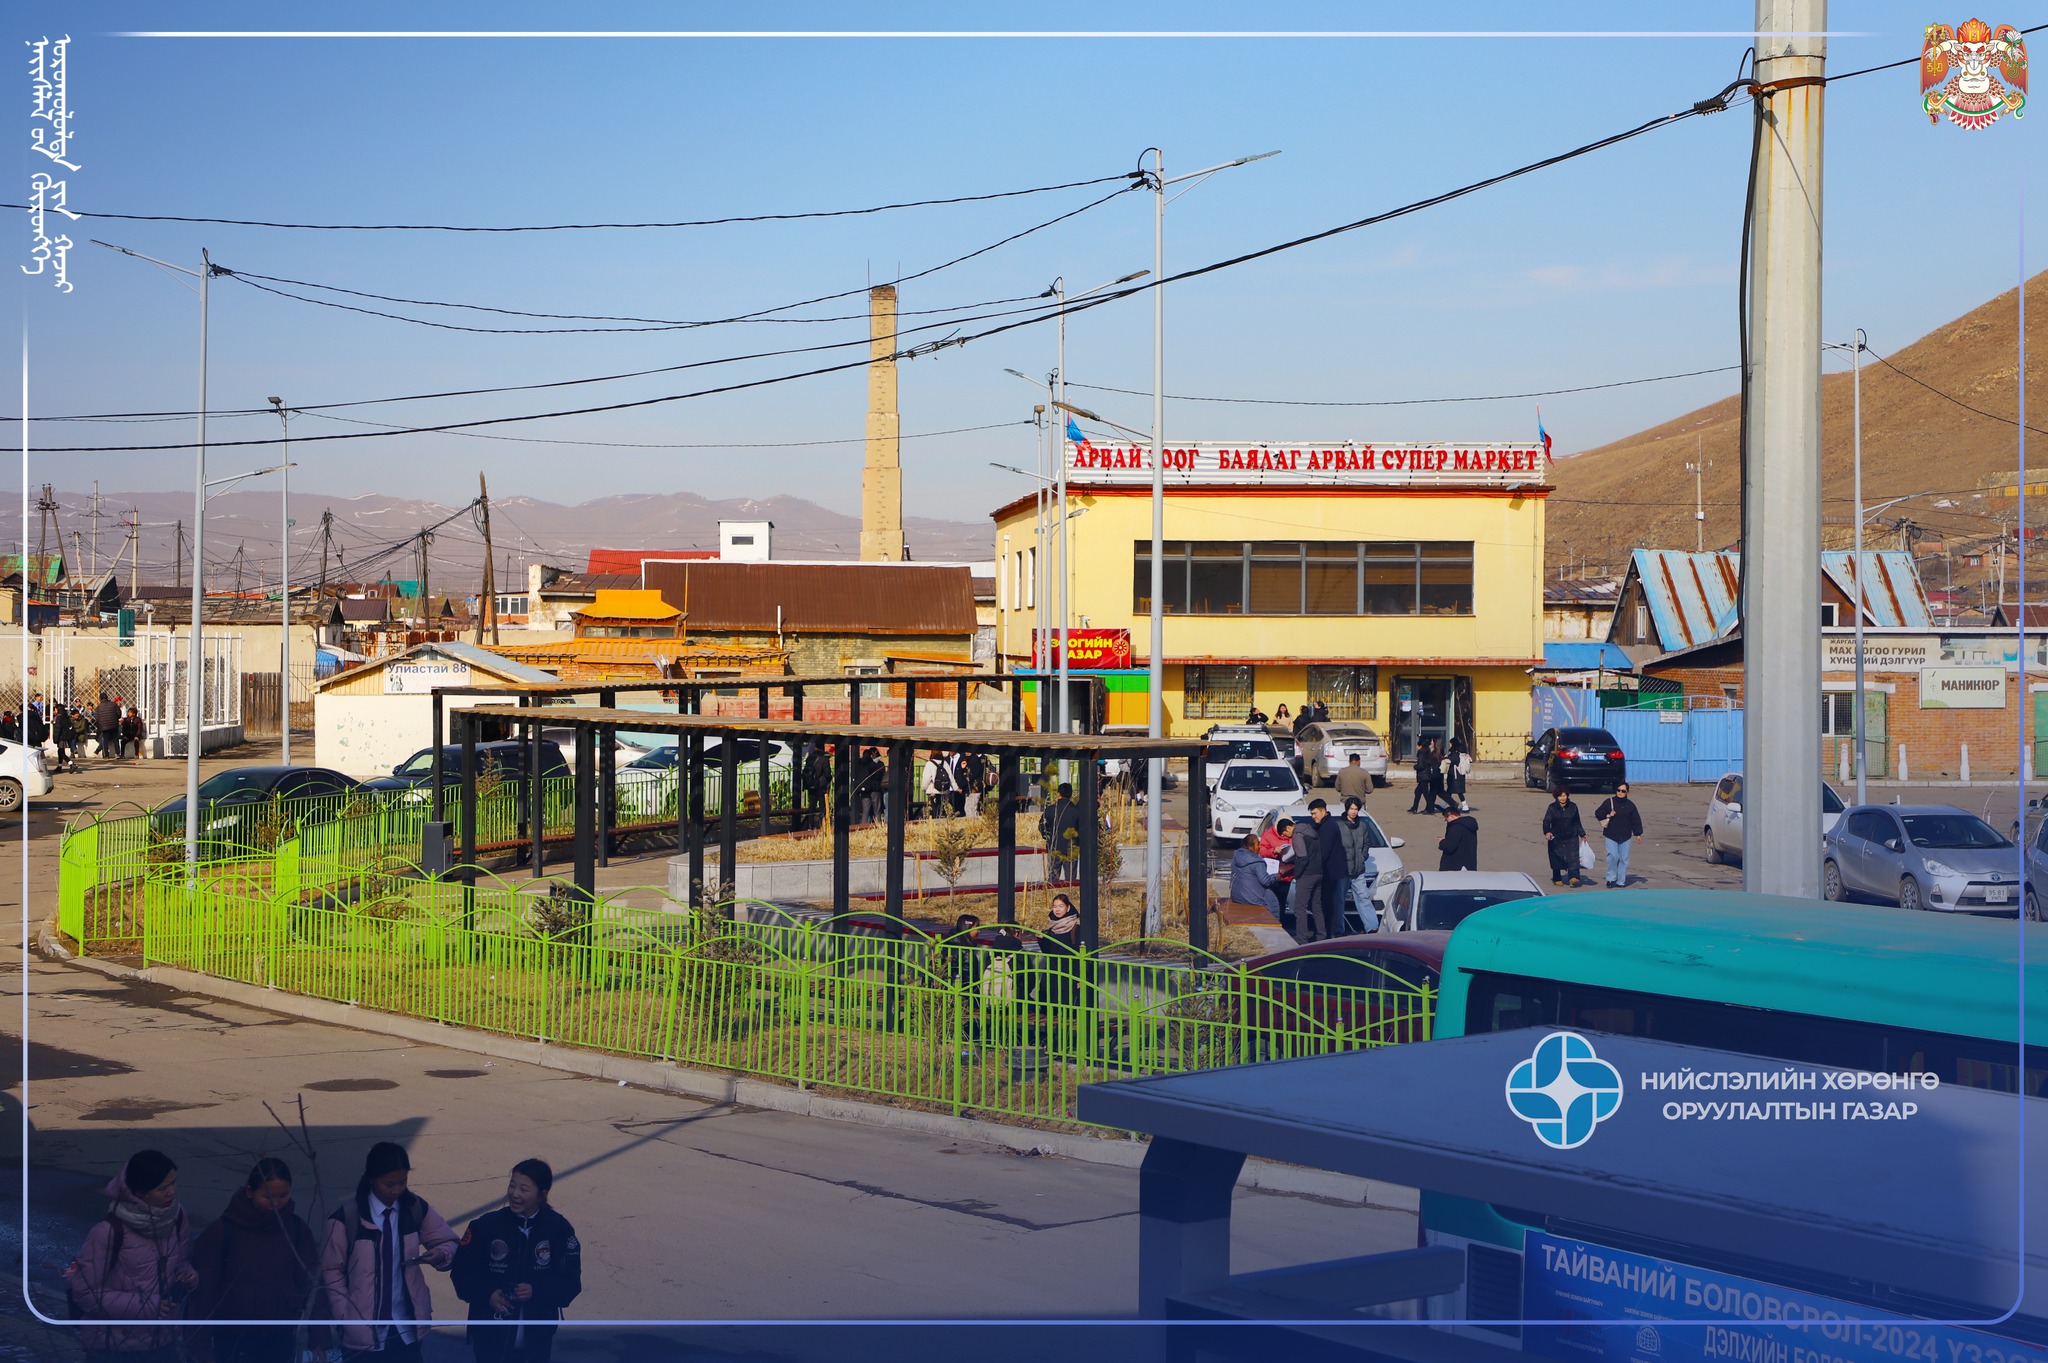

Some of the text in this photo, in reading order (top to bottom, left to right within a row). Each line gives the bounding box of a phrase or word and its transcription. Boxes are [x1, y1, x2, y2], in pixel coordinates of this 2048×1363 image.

[1073, 444, 1538, 470] АРВАЙ ООГ БАЯЛАГ АРВАЙ СУПЕР МАРКЕТ
[1050, 635, 1113, 649] ЗОГИЙН
[1064, 649, 1103, 660] АЗАР
[1829, 646, 1926, 656] МАХ ОГОО ГУРИЛ
[1829, 656, 1926, 666] ХҮНСИЙ ДЭЛГҮҮР
[388, 662, 467, 674] Улиастай 88
[1941, 679, 2000, 691] МАНИКЮР
[1541, 1244, 1677, 1301] ТАЙВАНИЙ
[1684, 1277, 1939, 1363] БОЛОВСРОЛ-2024
